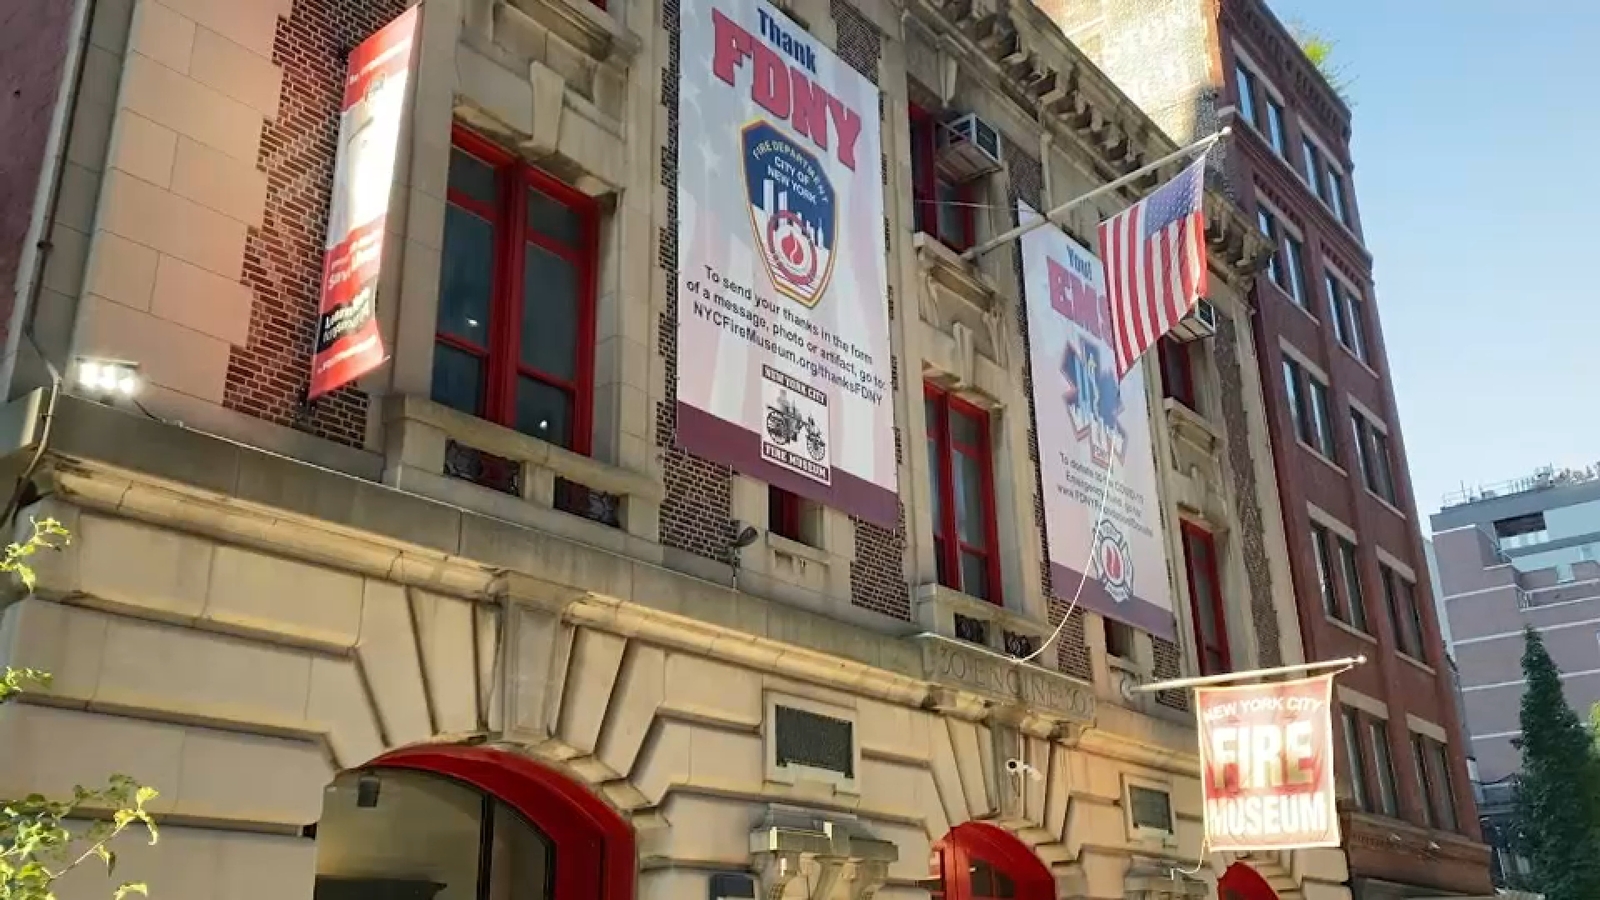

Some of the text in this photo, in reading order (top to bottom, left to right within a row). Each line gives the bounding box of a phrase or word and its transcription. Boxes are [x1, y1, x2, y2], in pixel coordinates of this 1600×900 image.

[757, 7, 817, 74] Thank
[711, 7, 861, 172] FDNY
[753, 140, 772, 160] FIRE
[774, 156, 809, 186] CITY OF
[767, 164, 818, 206] NEW YORK
[686, 281, 701, 294] of
[702, 288, 711, 301] a
[714, 293, 769, 332] message,
[772, 324, 804, 348] photo
[806, 342, 818, 354] or
[860, 369, 872, 383] go
[704, 264, 873, 366] To send your thanks in the form
[693, 301, 882, 406] NYCFireMuseum.org/thanksFDNY
[764, 367, 826, 406] NEW YORK CITY
[765, 443, 827, 480] FIRE MUSEUM
[1204, 696, 1324, 721] NEW YORK CITY
[1212, 720, 1315, 790] FIRE
[1206, 791, 1328, 837] MUSEUM
